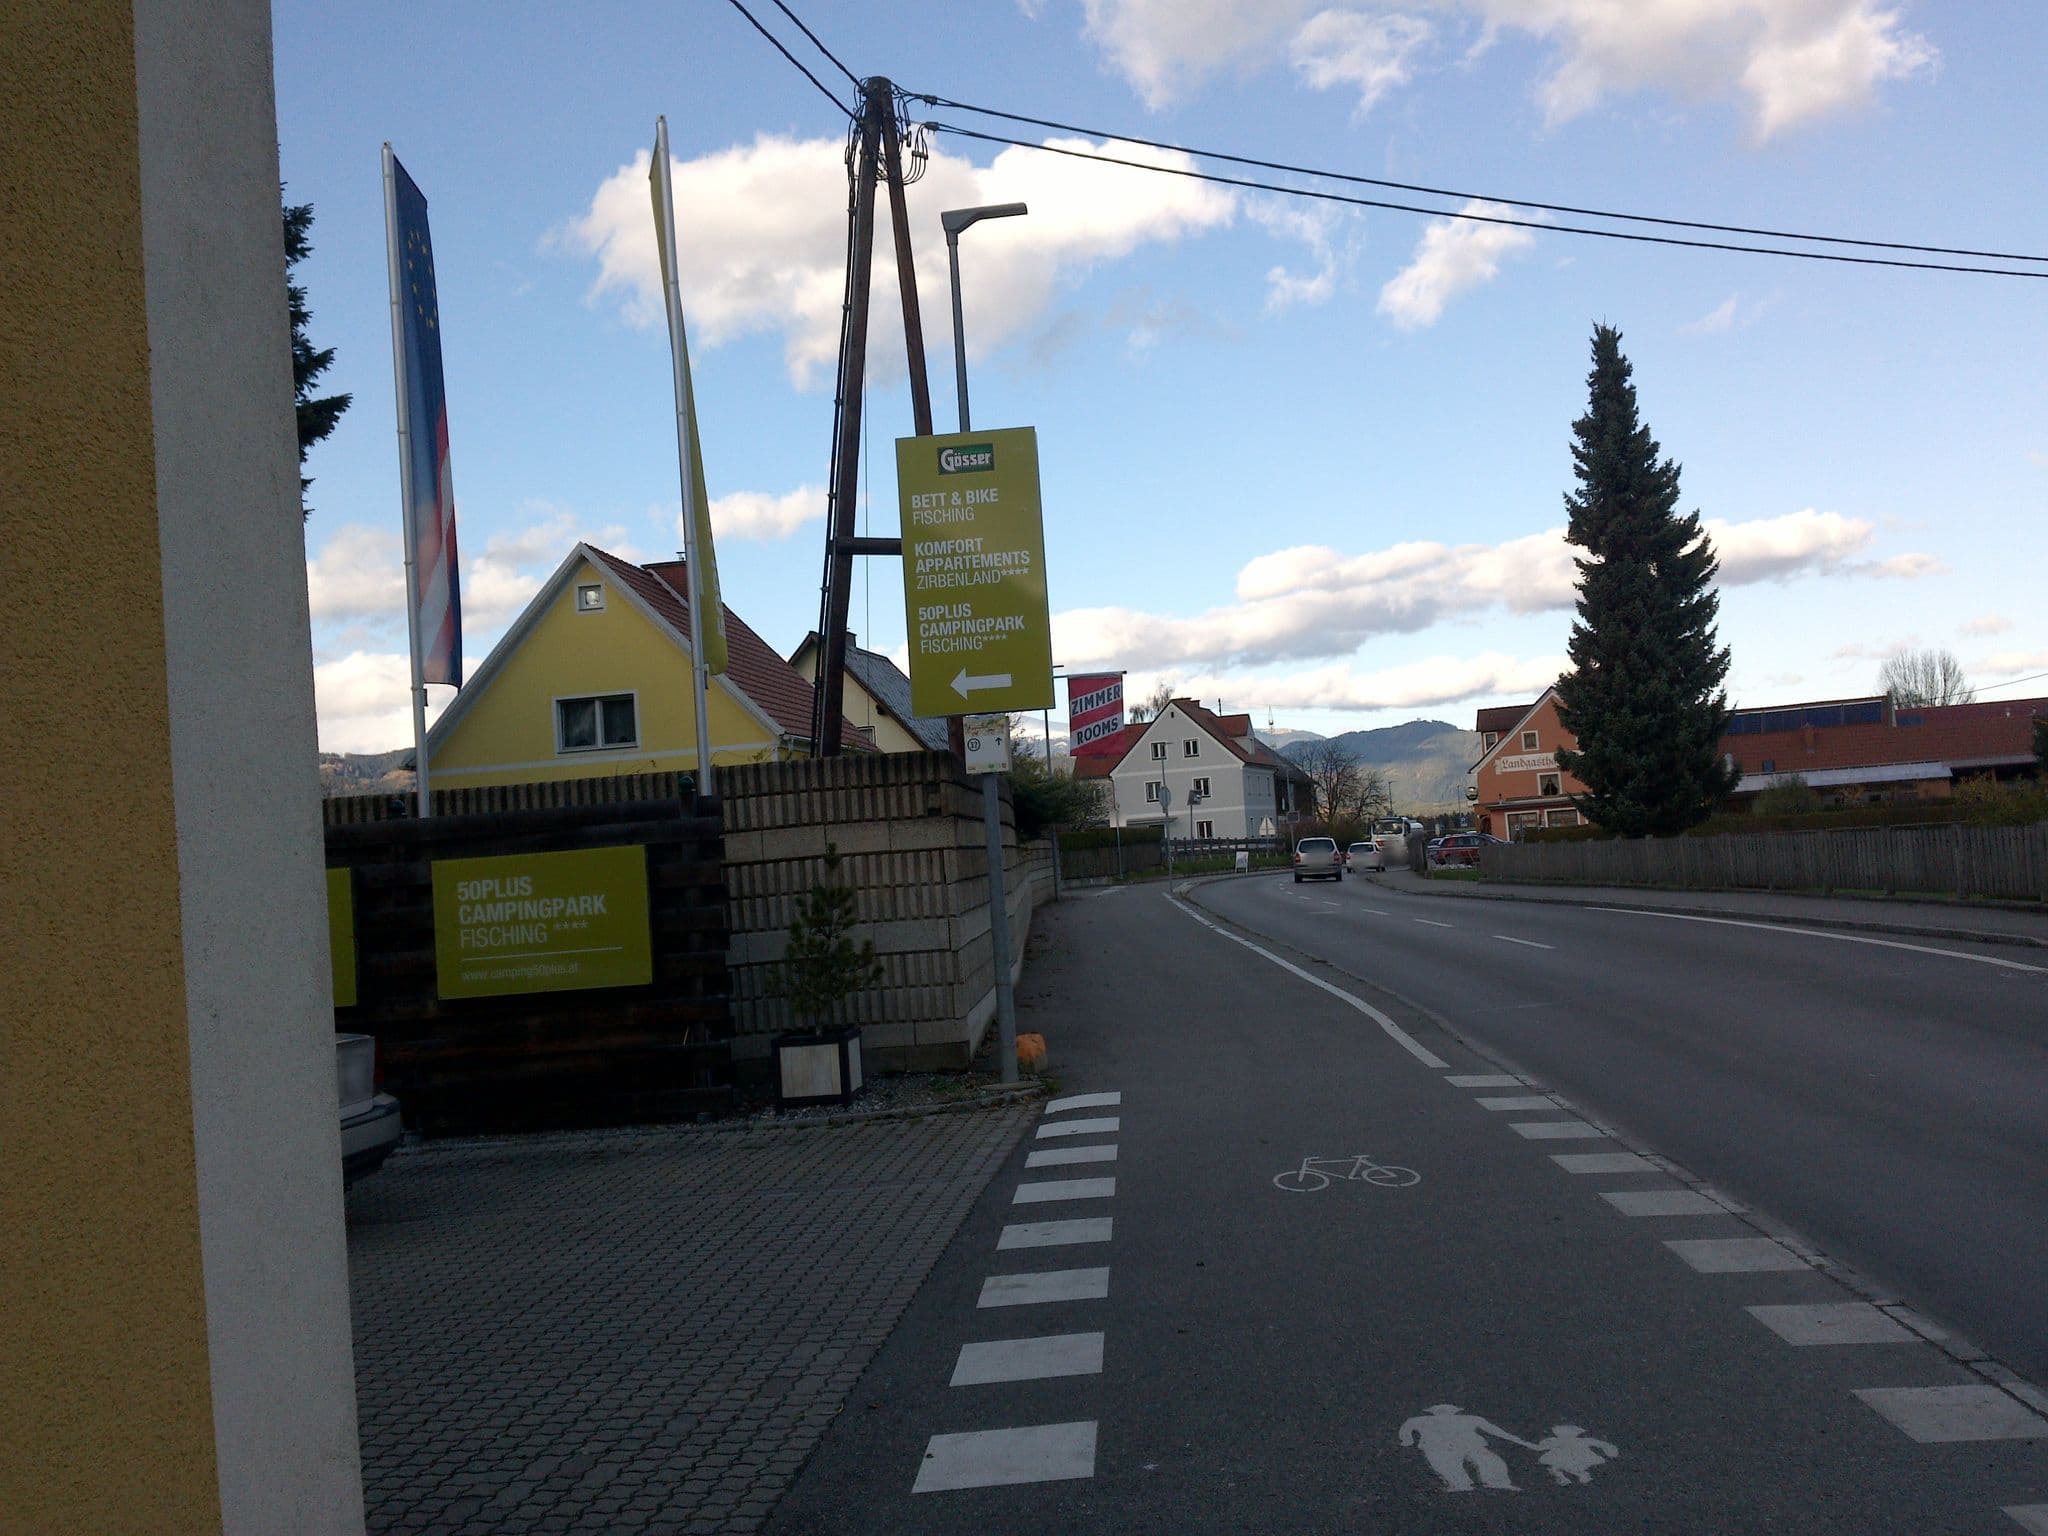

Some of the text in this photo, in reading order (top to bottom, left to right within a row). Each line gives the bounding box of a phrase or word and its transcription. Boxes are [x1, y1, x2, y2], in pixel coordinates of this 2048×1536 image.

[941, 449, 992, 472] Gösser
[912, 488, 999, 508] BETT & BIKE
[913, 506, 975, 525] FISCHING
[915, 538, 984, 557] KOMFORT
[915, 551, 1031, 574] APPARTEMENTS
[917, 569, 1001, 590] ZIRBENLAND
[919, 603, 972, 622] 50PLUS
[920, 615, 1025, 638] CAMPINGPARK
[921, 635, 983, 654] FISCHING
[1071, 684, 1120, 715] ZIMMER
[1077, 717, 1119, 745] ROOMS
[456, 876, 533, 902] 50PLUS
[458, 894, 608, 925] CAMPINGPARK
[460, 923, 548, 949] FISCHING
